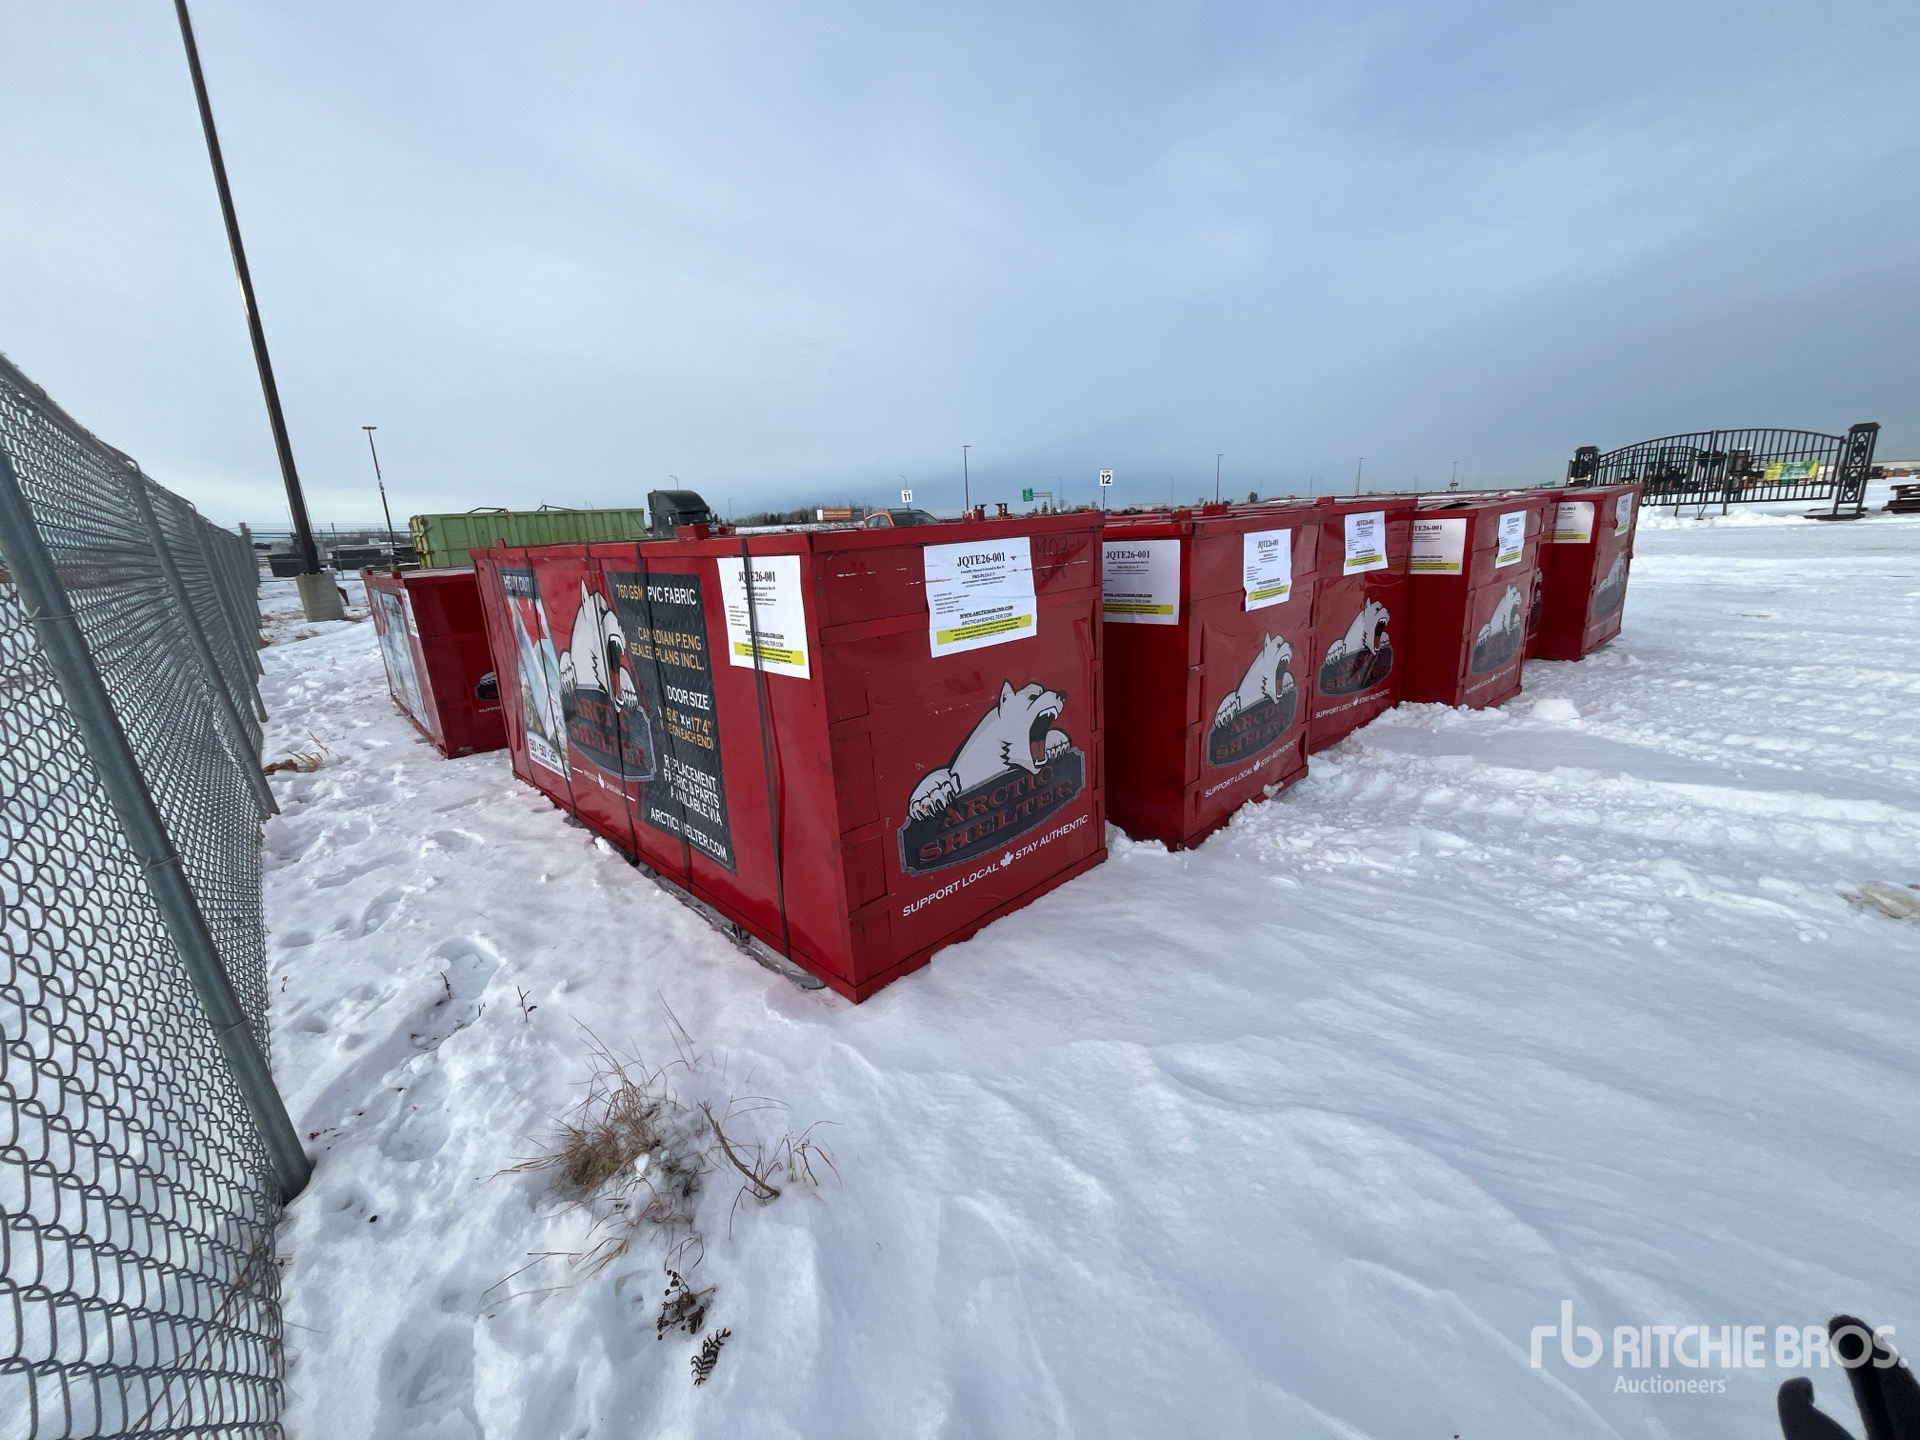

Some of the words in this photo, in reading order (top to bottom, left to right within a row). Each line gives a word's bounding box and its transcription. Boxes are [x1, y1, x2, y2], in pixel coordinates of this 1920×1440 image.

[1101, 474, 1111, 484] 12
[903, 493, 911, 501] 11
[957, 552, 1006, 568] JQTE26-001
[1105, 550, 1150, 560] JQTE26-001
[738, 571, 776, 584] JQE26-001
[647, 586, 663, 602] PVC
[664, 588, 697, 605] FABRIC
[655, 648, 680, 666] PLANS
[681, 652, 704, 670] INCL.
[666, 685, 689, 705] DOOR
[689, 691, 710, 710] SIZE
[574, 695, 630, 733] ARCTC
[1205, 776, 1234, 798] SUPPORT
[1234, 767, 1253, 782] LOCAL
[694, 784, 720, 809] PARTS
[938, 765, 1055, 832] ARCTIC
[708, 806, 723, 826] VIA
[918, 779, 1074, 866] SHELTER
[902, 880, 961, 917] SUPPORT
[962, 862, 999, 888] LOCAL
[1015, 839, 1039, 860] STAY
[1039, 814, 1089, 848] AUTHENTIC
